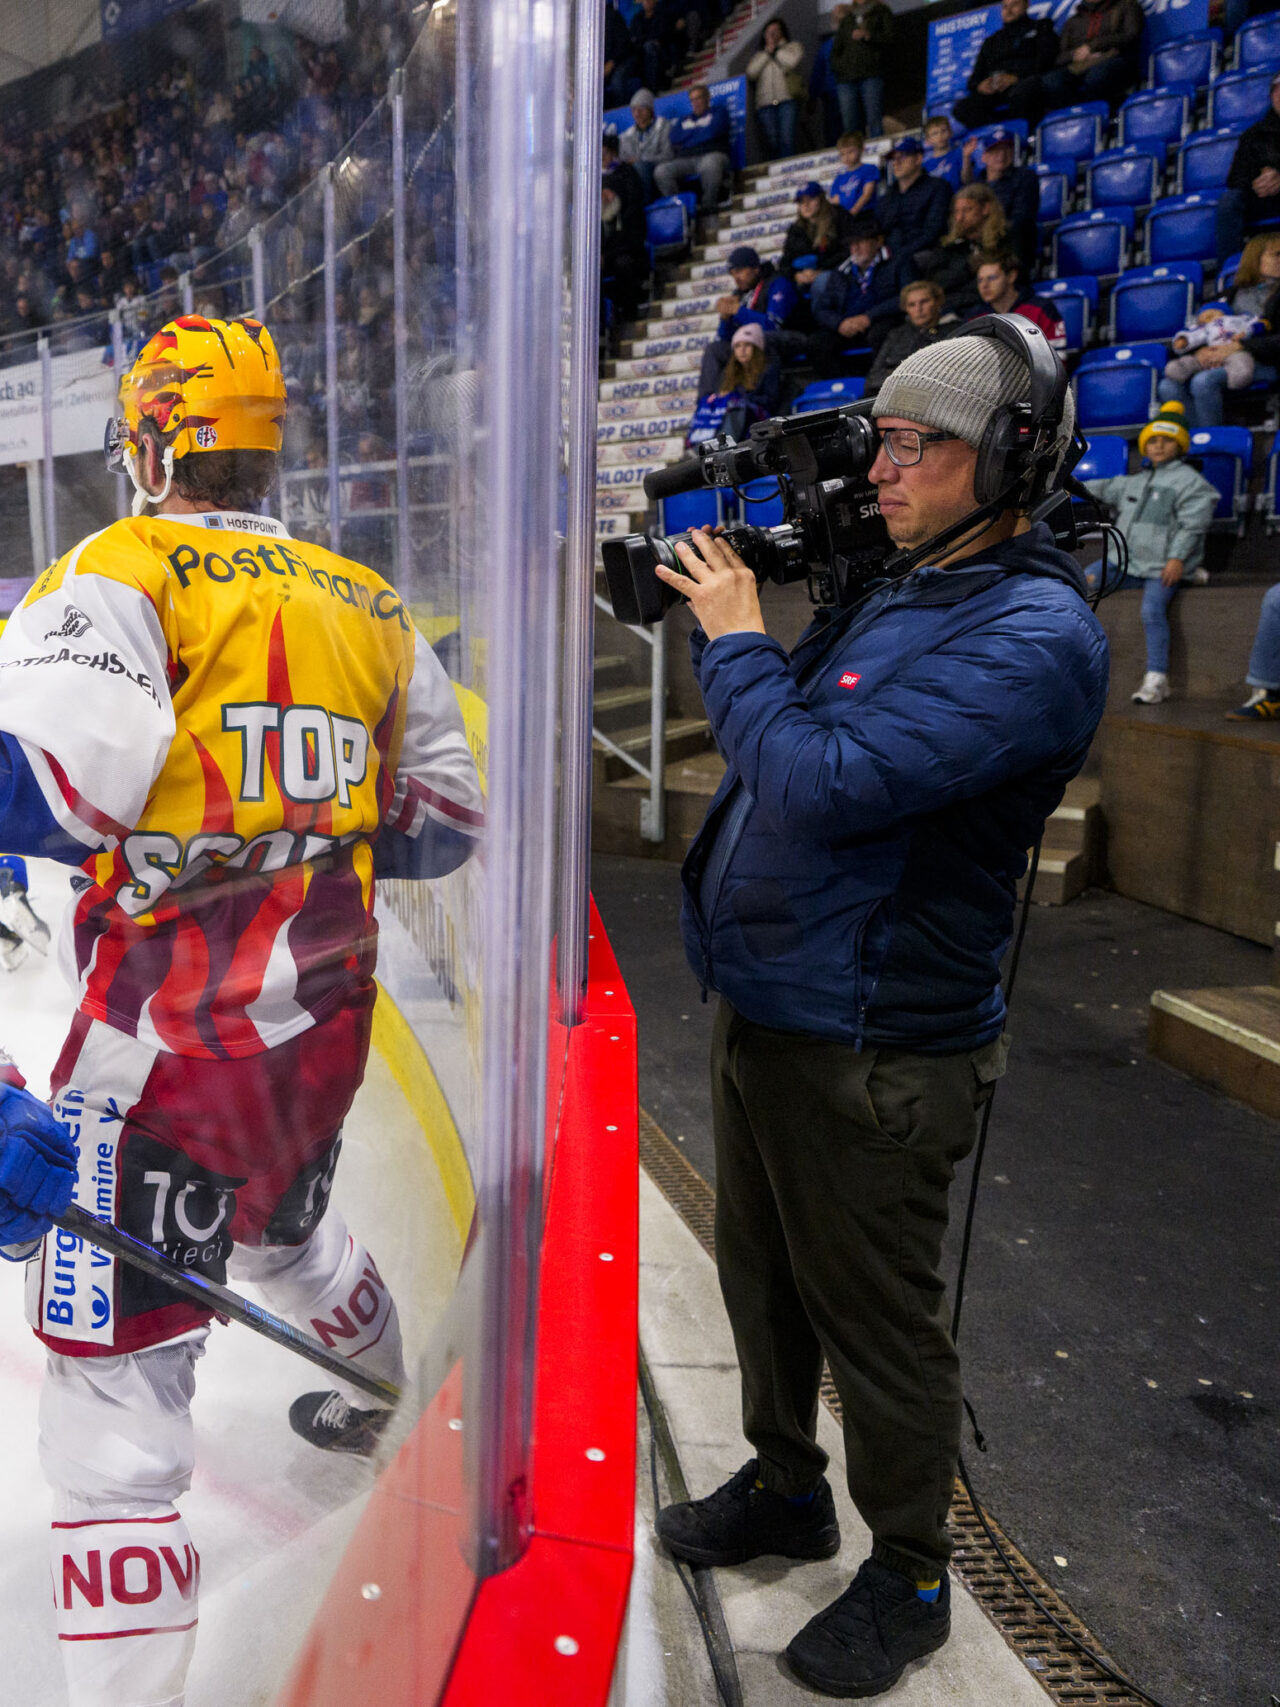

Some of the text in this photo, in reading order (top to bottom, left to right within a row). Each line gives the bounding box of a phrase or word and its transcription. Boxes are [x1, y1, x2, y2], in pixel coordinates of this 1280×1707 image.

[612, 382, 650, 398] HOPP
[859, 503, 880, 519] SR
[227, 517, 278, 536] HOSTPOINT
[840, 674, 858, 686] SRF
[221, 701, 369, 810] TOP
